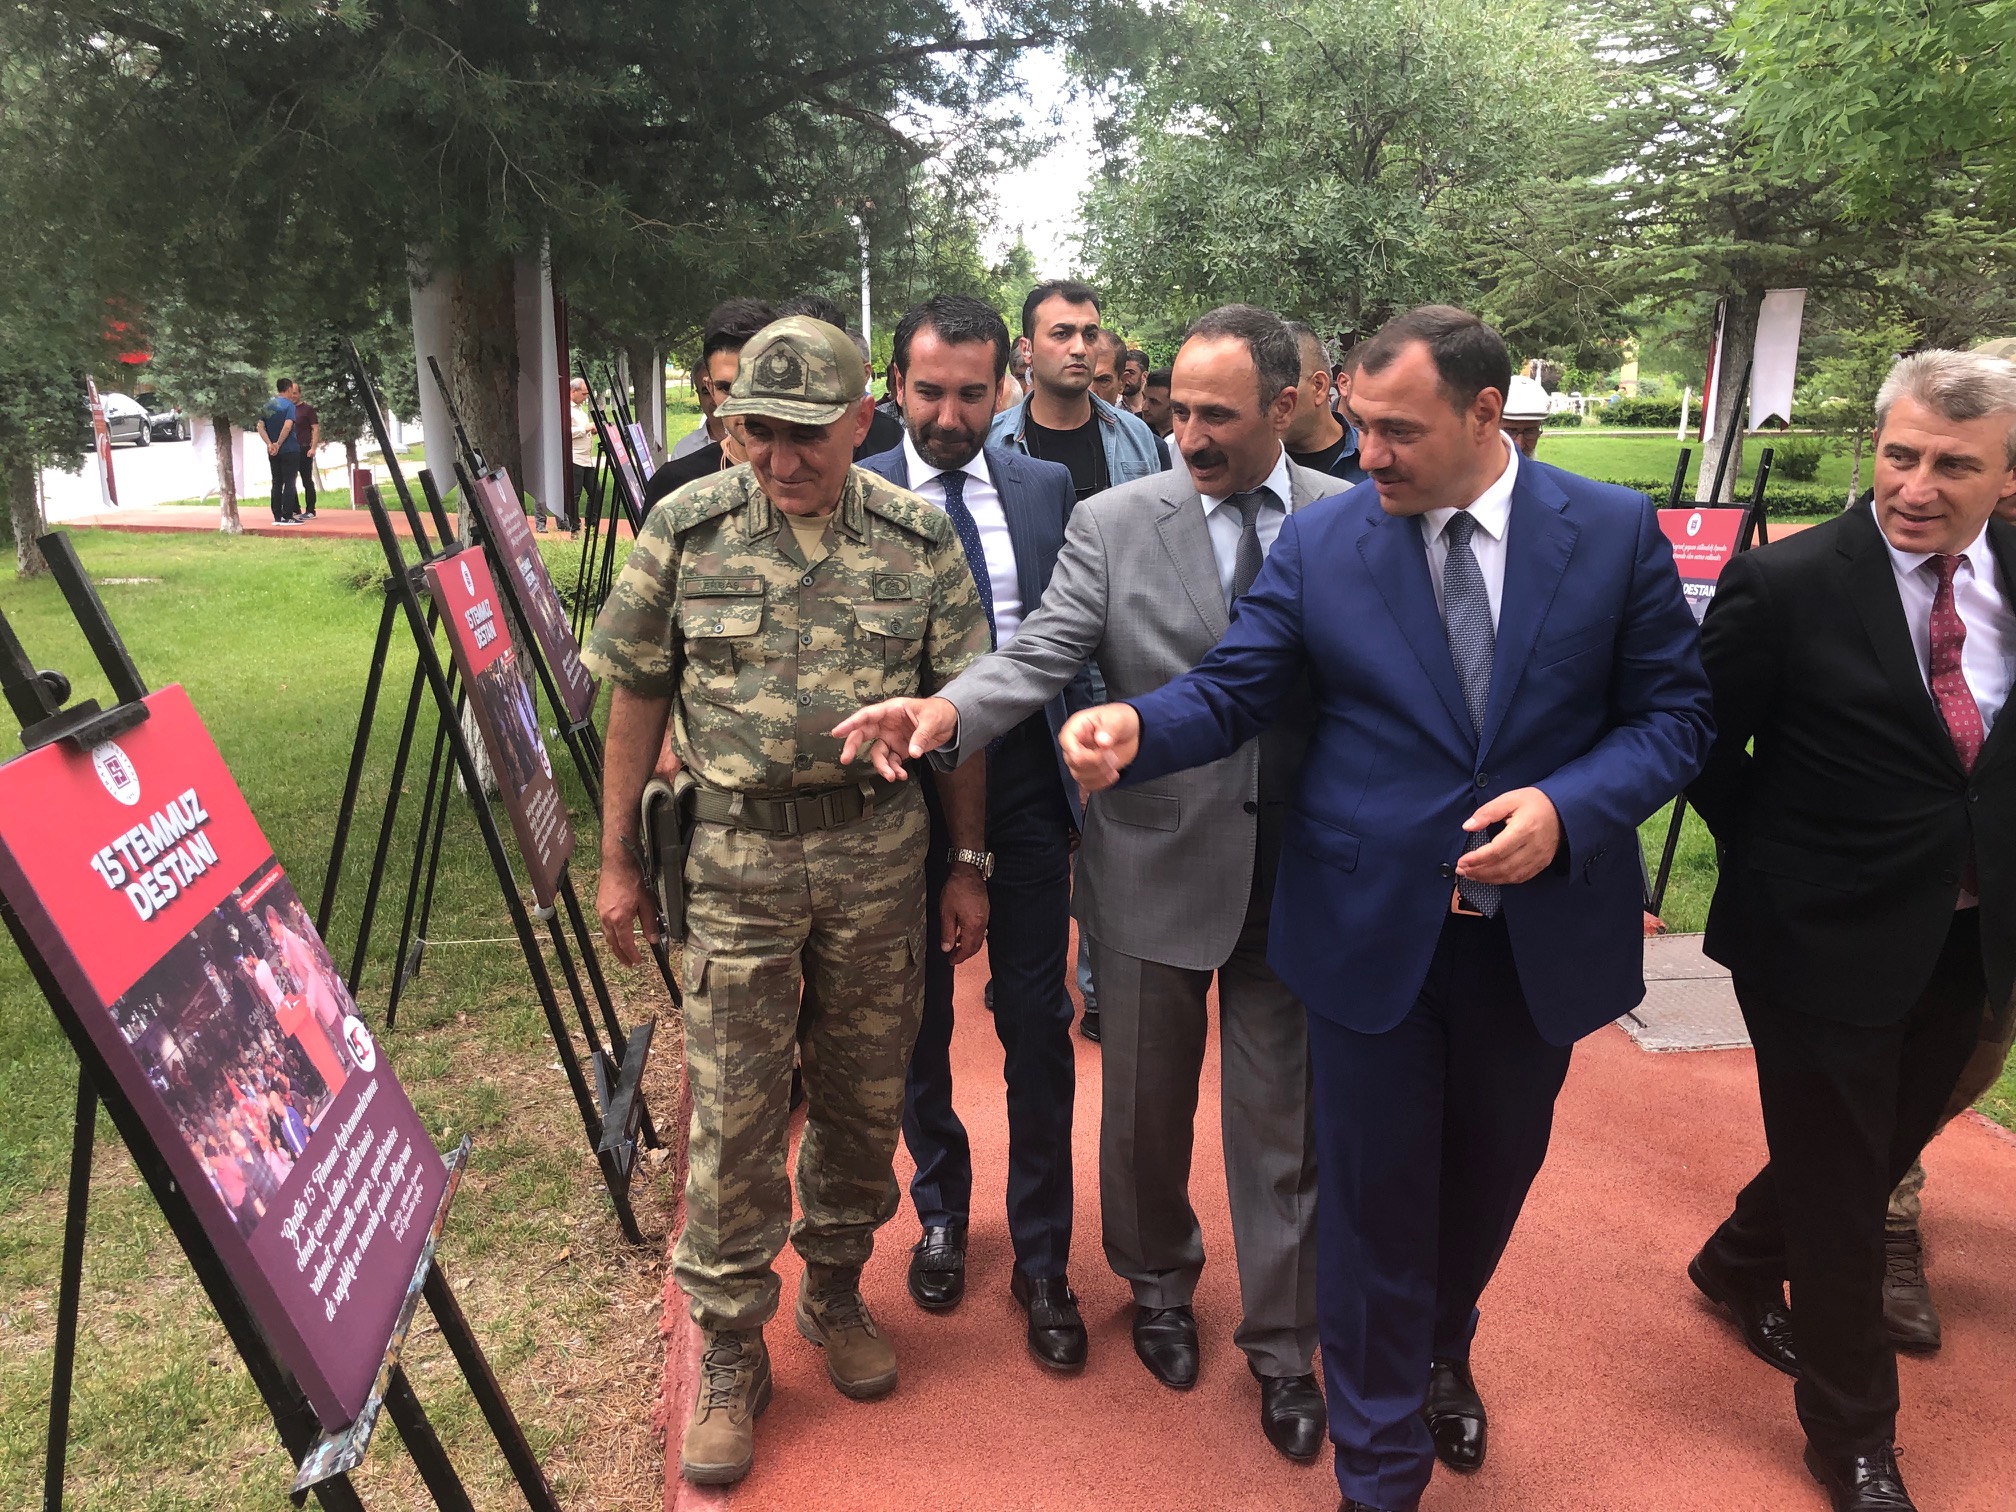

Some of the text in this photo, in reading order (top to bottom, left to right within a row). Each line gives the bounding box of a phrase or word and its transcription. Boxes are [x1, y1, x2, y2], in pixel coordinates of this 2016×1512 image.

[1683, 583, 1716, 597] DESTAN
[474, 620, 497, 650] DESTANI
[90, 788, 209, 890] 15 TEMMUZ
[125, 830, 219, 922] DESTANI
[303, 1180, 316, 1207] 15
[311, 1145, 340, 1193] Temmuz
[297, 1227, 323, 1273] olmak
[313, 1204, 333, 1239] üzere
[323, 1177, 348, 1211] bütün
[377, 1181, 394, 1222] günler
[309, 1243, 337, 1296] rahmet,
[329, 1205, 357, 1256] minnetle
[356, 1205, 380, 1254] huzurlu
[332, 1256, 358, 1306] sağlıklı
[352, 1247, 363, 1266] ve
[324, 1297, 337, 1322] de
